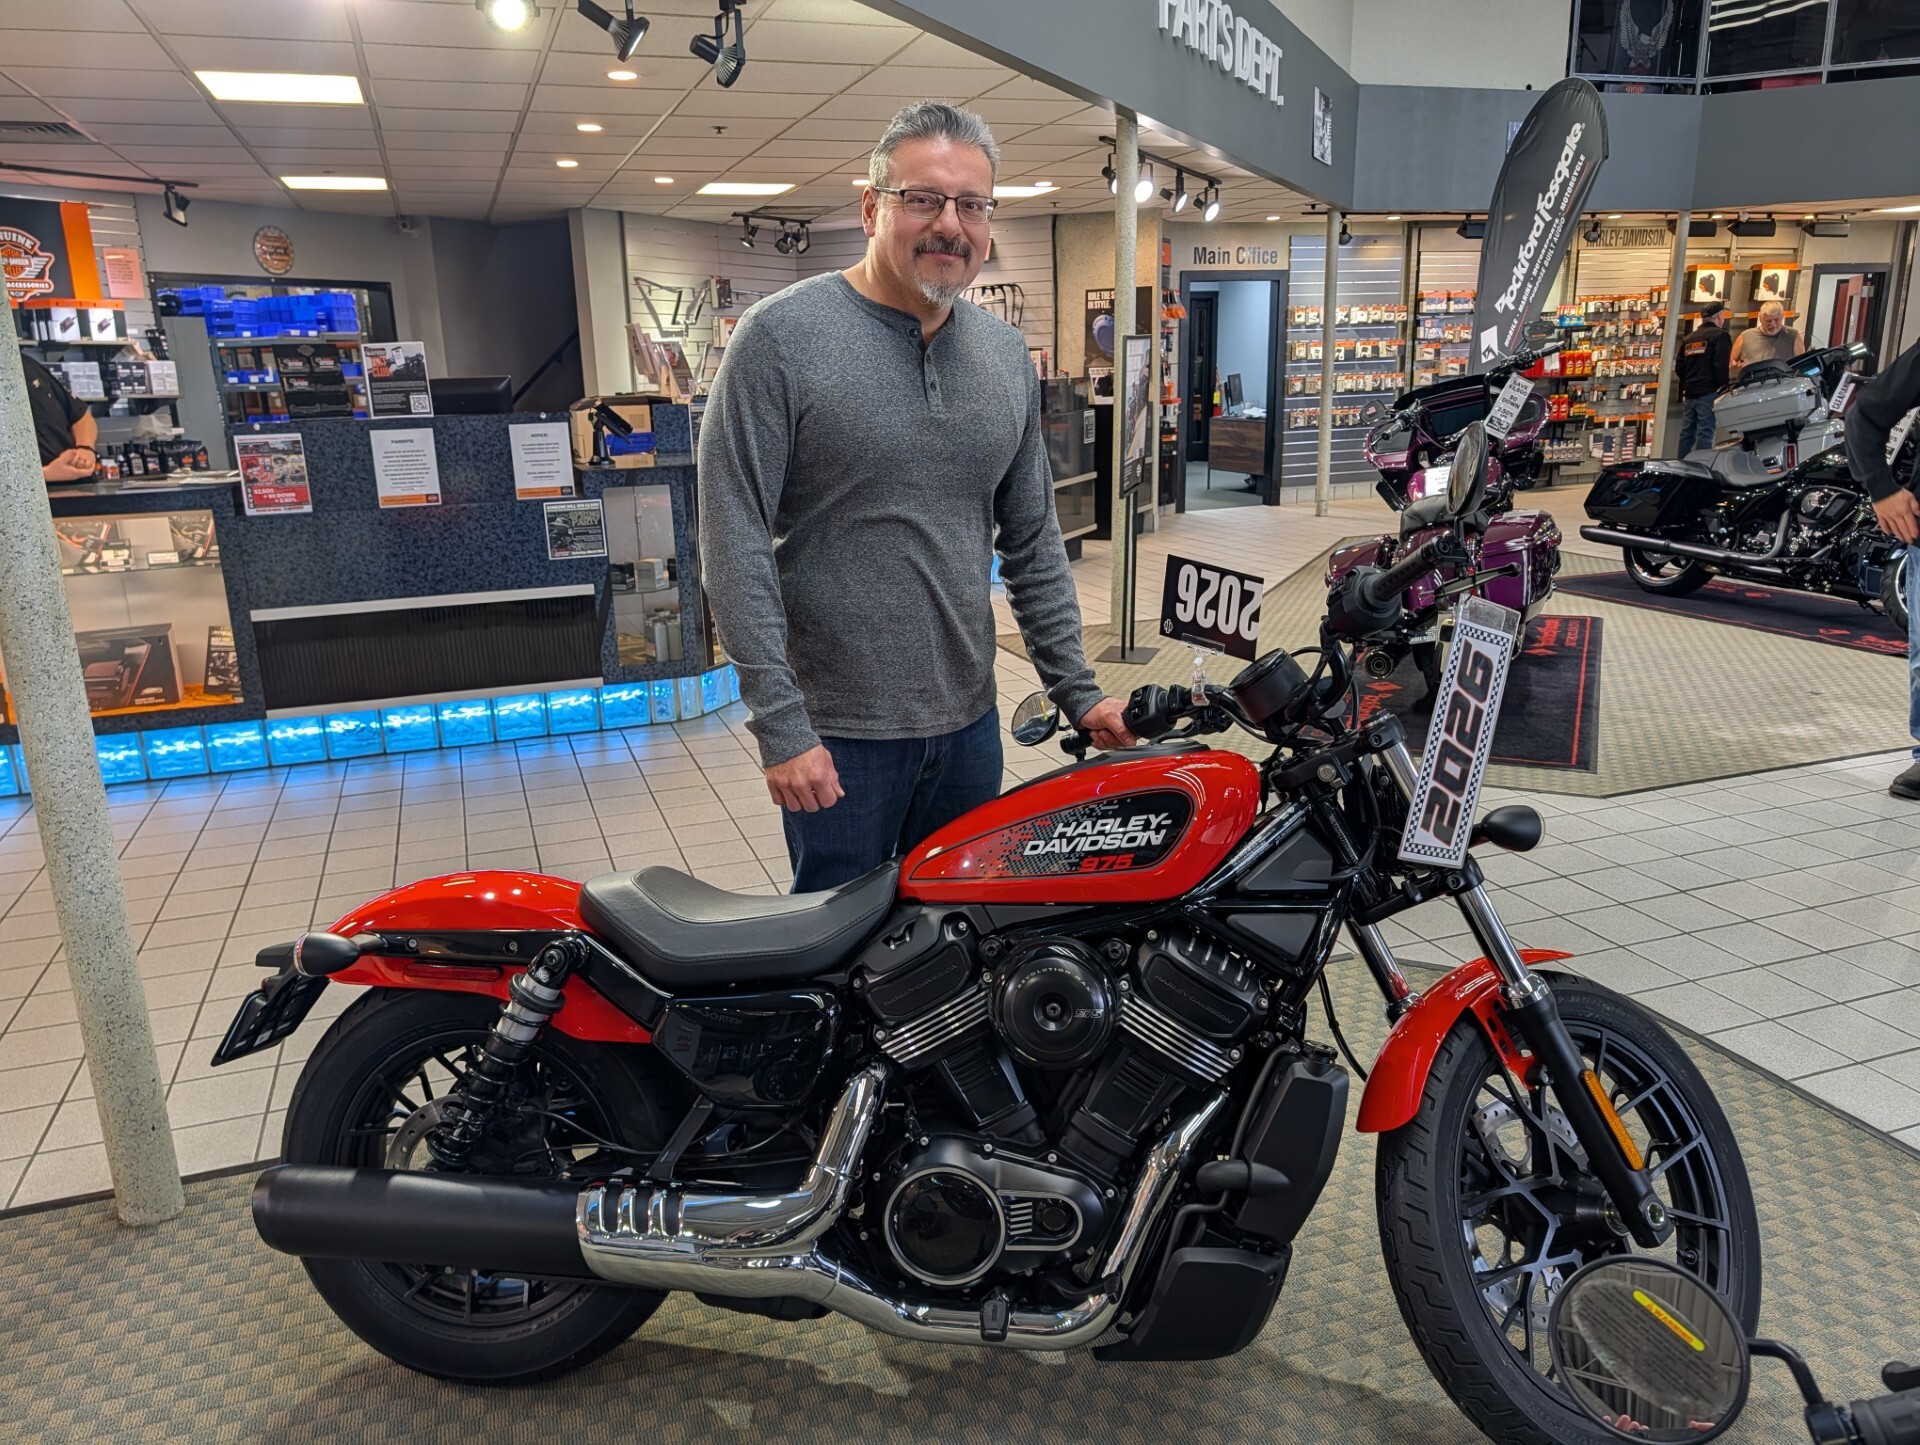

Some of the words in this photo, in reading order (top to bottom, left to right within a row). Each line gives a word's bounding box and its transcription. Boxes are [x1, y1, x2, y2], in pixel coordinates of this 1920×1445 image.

[1234, 16, 1284, 106] DEPT.
[0, 231, 35, 249] NUINE
[1504, 317, 1519, 348] MOBILE
[1518, 281, 1533, 313] MARINE
[1531, 217, 1561, 277] MOTORSPORTS
[1560, 153, 1586, 211] MOTORCYCLE
[1544, 241, 1557, 268] BUILT
[1553, 216, 1566, 245] AUDIO
[1586, 228, 1666, 248] RLEY-DAVIDSON
[1193, 246, 1231, 265] Main
[1236, 246, 1278, 265] Office
[6, 281, 49, 289] ACCESSORIES
[1508, 384, 1528, 397] $2,500
[1512, 380, 1529, 390] SAVE
[1831, 382, 1850, 410] CLEARAN
[1496, 406, 1514, 418] 2.50%
[1501, 397, 1521, 410] DOWN
[1175, 564, 1263, 641] 2026
[1420, 639, 1494, 847] 2026
[1053, 812, 1172, 838] HARLEY-
[1023, 829, 1167, 856] DAVIDSON
[1078, 854, 1135, 872] 975
[1017, 967, 1071, 989] REVOLUTION
[1074, 975, 1091, 992] MAX
[1653, 1308, 1694, 1343] WARNING
